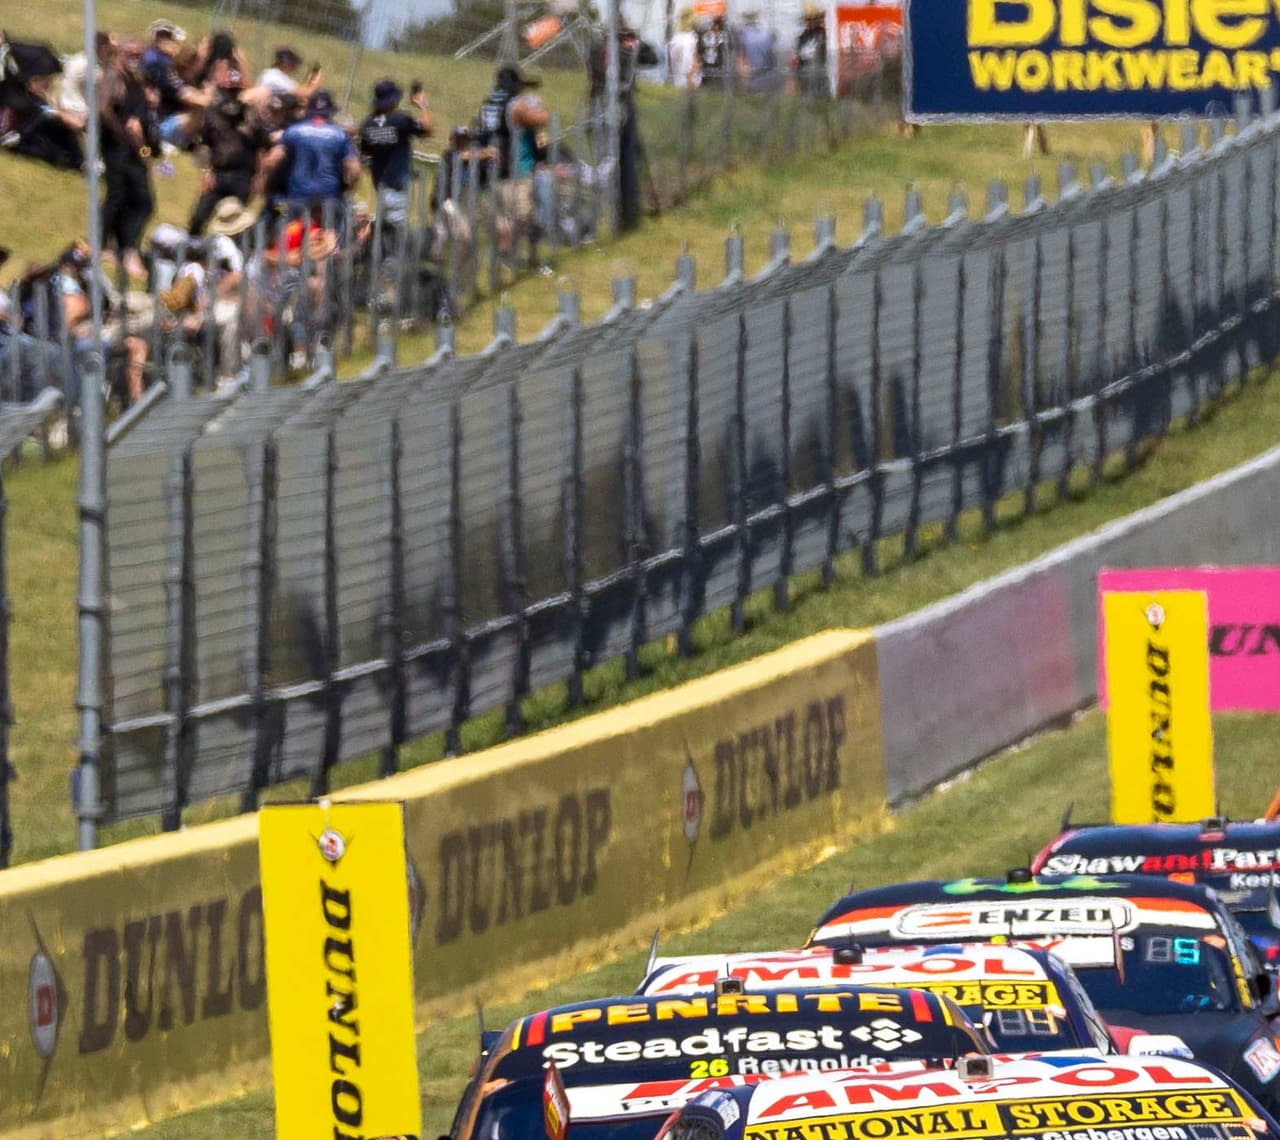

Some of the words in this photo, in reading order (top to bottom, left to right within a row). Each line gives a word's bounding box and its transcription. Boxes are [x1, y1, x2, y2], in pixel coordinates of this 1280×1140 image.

[967, 49, 1272, 92] WORKWEAR
[1147, 640, 1175, 822] DUNLO
[710, 695, 846, 842] DUNLOP
[435, 787, 612, 944] DUNLOP
[1041, 853, 1144, 877] Shaw
[978, 906, 1111, 925] ENZED
[78, 884, 266, 1055] DUNLO
[656, 956, 1035, 994] AMPOL
[550, 991, 904, 1034] PENRITE
[940, 983, 1043, 1007] RAGE
[542, 1024, 845, 1070] Steadfast
[689, 1058, 730, 1080] 26
[737, 1054, 887, 1076] Reynolds
[756, 1065, 1214, 1119] AMPOL
[1015, 1091, 1233, 1132] STORAGE
